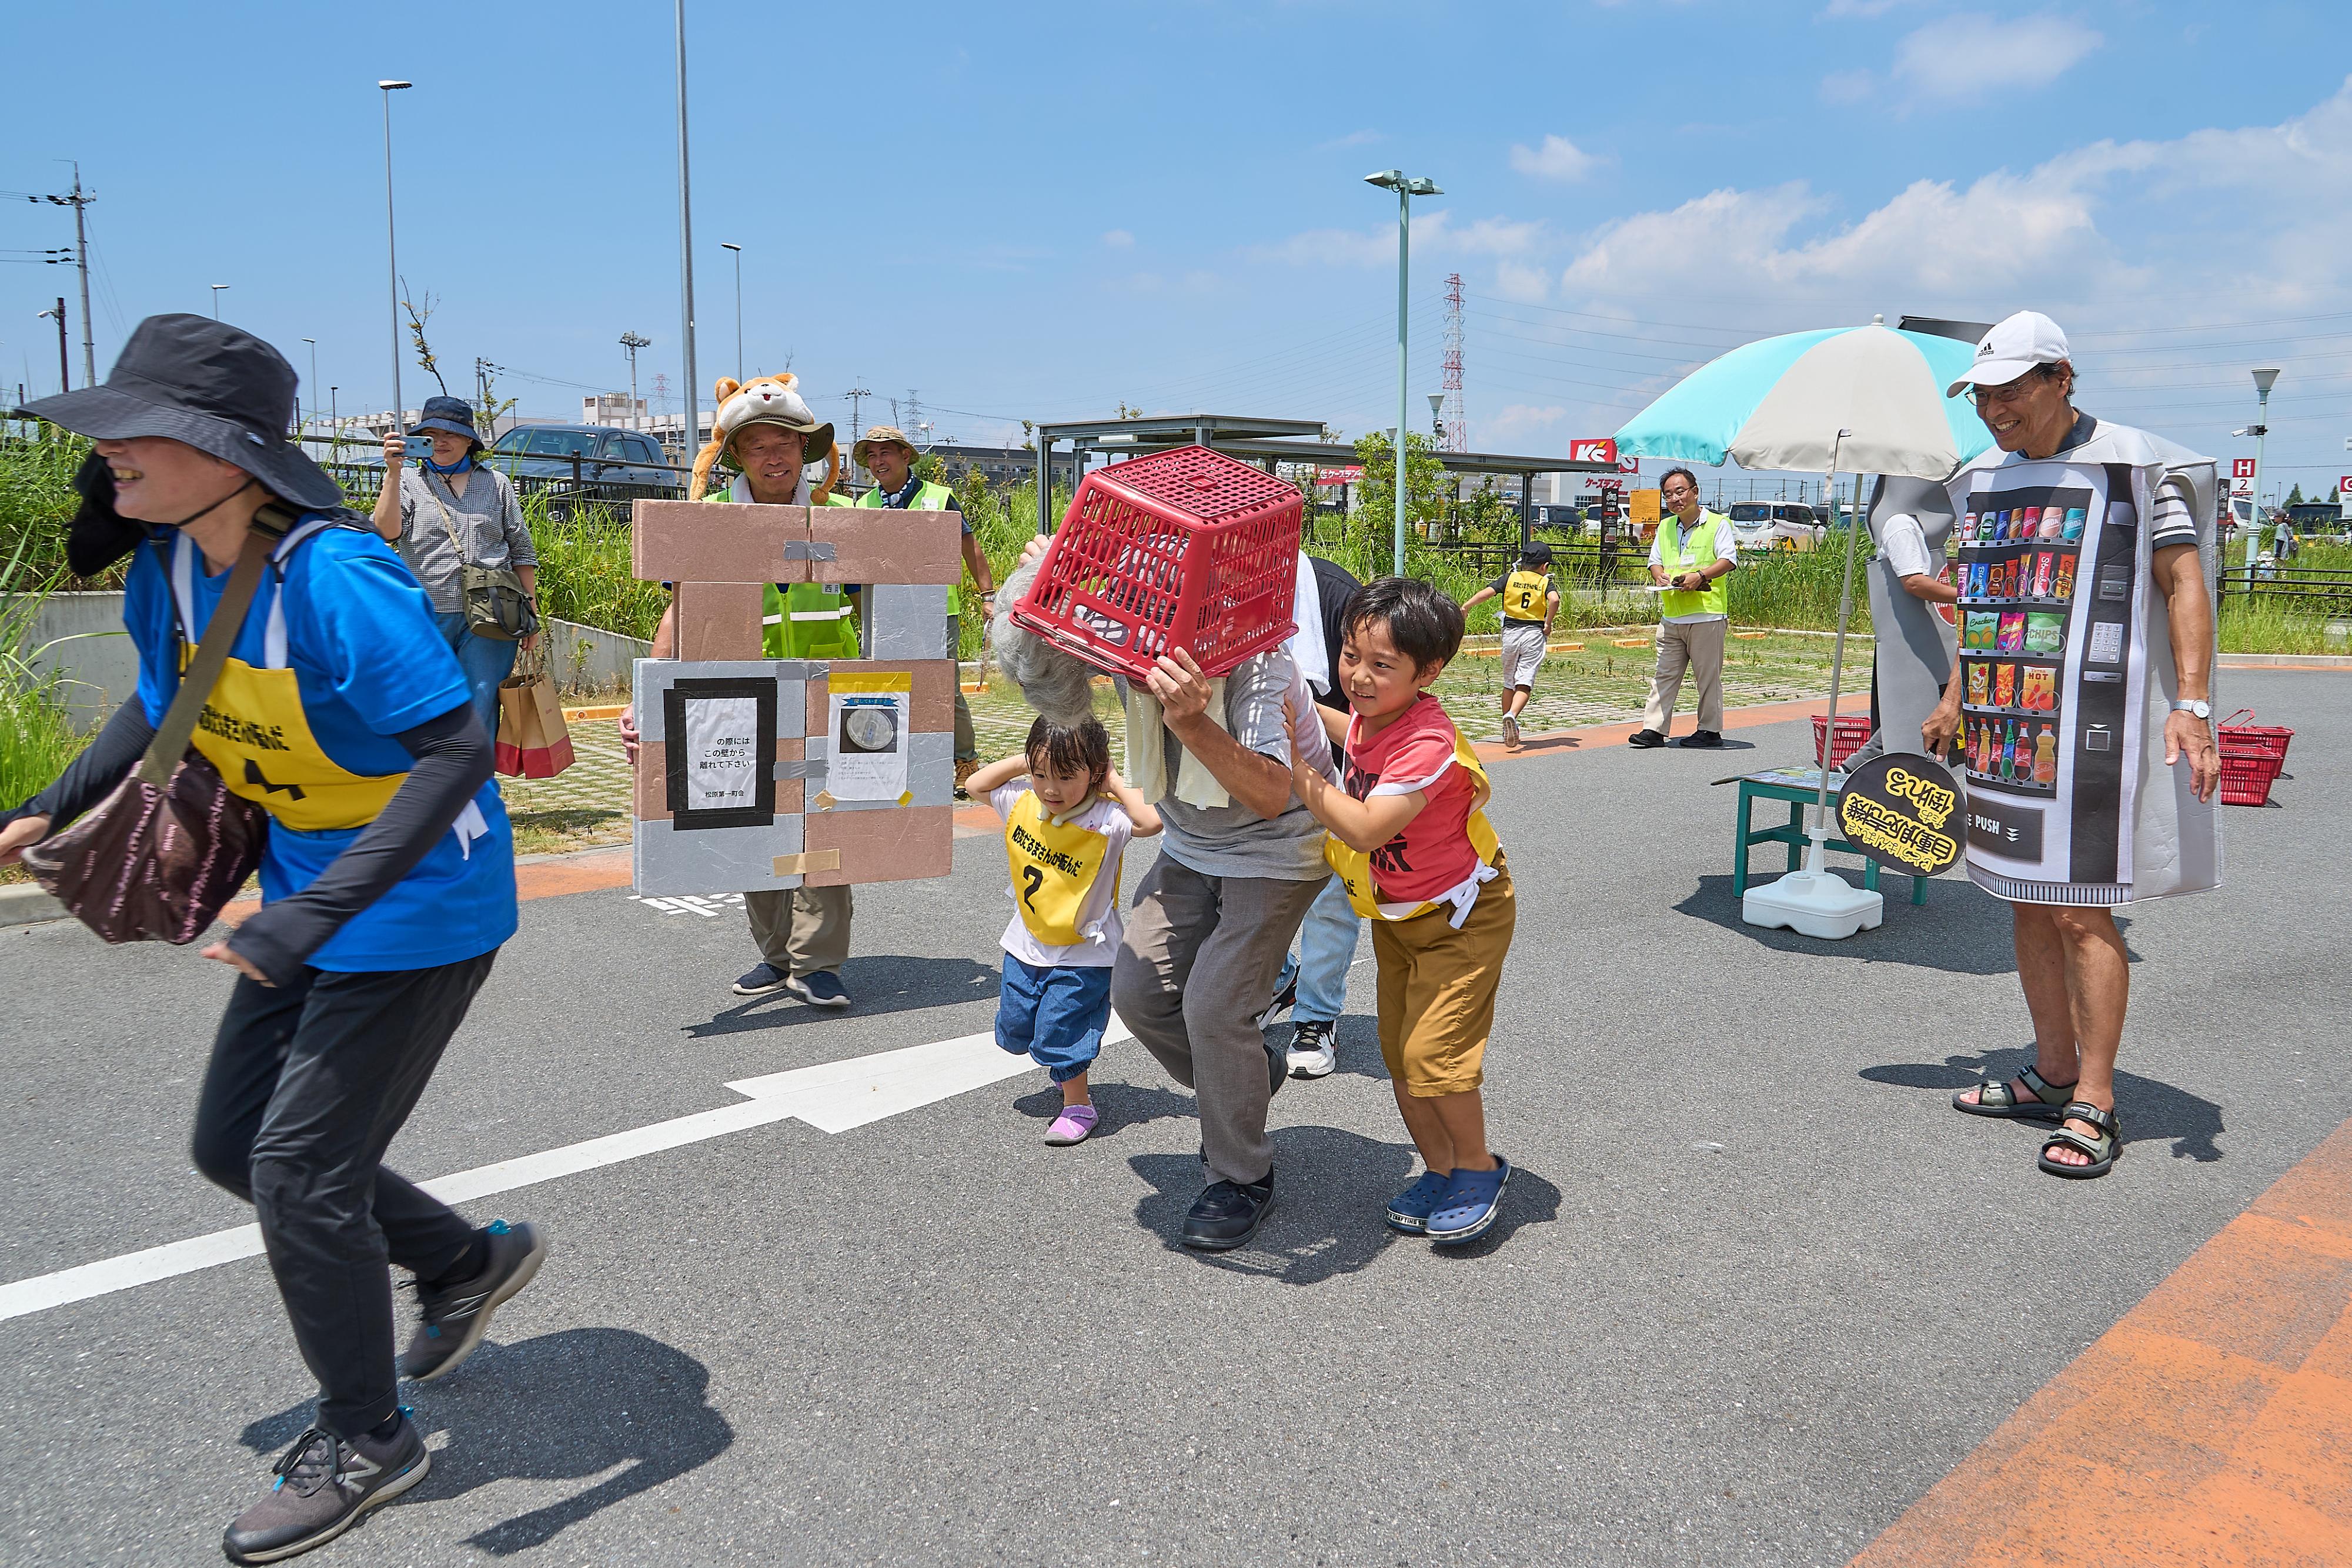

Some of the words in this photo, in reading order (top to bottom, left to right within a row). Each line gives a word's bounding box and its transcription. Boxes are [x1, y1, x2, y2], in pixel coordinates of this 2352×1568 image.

[2237, 461, 2251, 475] H
[2240, 479, 2247, 490] 2
[1521, 592, 1531, 609] 6
[2029, 628, 2057, 640] CHIPS
[717, 737, 750, 745] の際には
[705, 749, 745, 758] この壁から
[2016, 753, 2029, 761] Soda
[699, 760, 750, 770] 離れて下さい
[2036, 764, 2052, 774] Soda
[705, 790, 744, 798] 松原第一町会
[1889, 770, 1951, 815] 倒れる
[1845, 795, 1954, 862] 自動販売機
[1976, 814, 2000, 835] PUSH
[1023, 864, 1043, 915] 2
